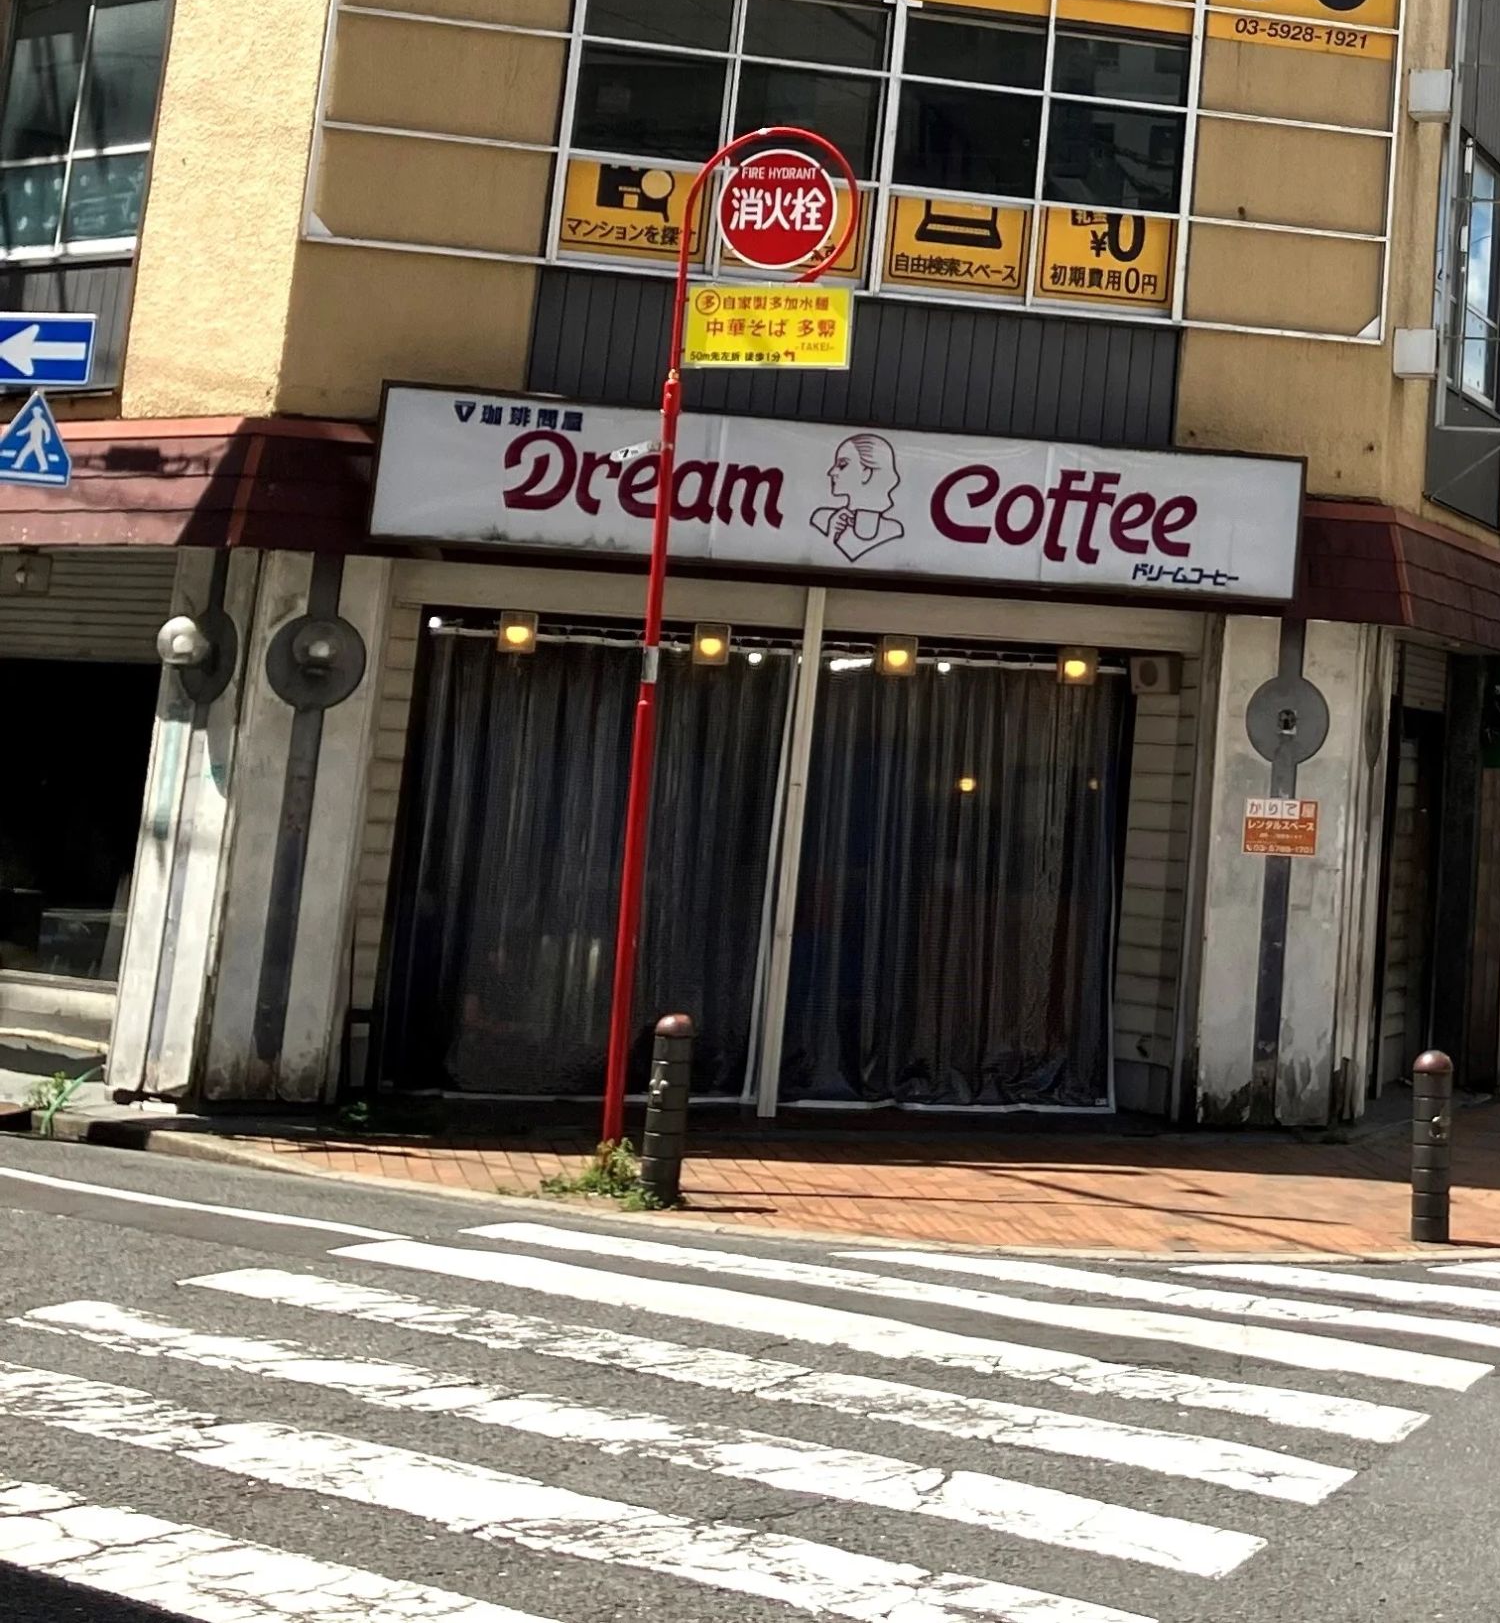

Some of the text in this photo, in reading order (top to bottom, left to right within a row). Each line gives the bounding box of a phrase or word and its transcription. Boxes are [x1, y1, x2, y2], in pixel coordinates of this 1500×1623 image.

[1235, 18, 1368, 49] 03-5928-1921
[742, 166, 817, 181] FIRE HYDRANT
[730, 187, 826, 232] 消火栓
[894, 252, 1017, 283] 自由検索スペース
[1050, 264, 1157, 295] 初期費用0円
[706, 318, 789, 338] 中華そば
[690, 351, 781, 362] 50m先左折 徒歩1分
[480, 404, 584, 432] 珈琲問屋
[503, 430, 1198, 565] Dream Coffee
[1132, 563, 1239, 586] ドリームコーヒー
[1247, 820, 1315, 831] レンタルスペース
